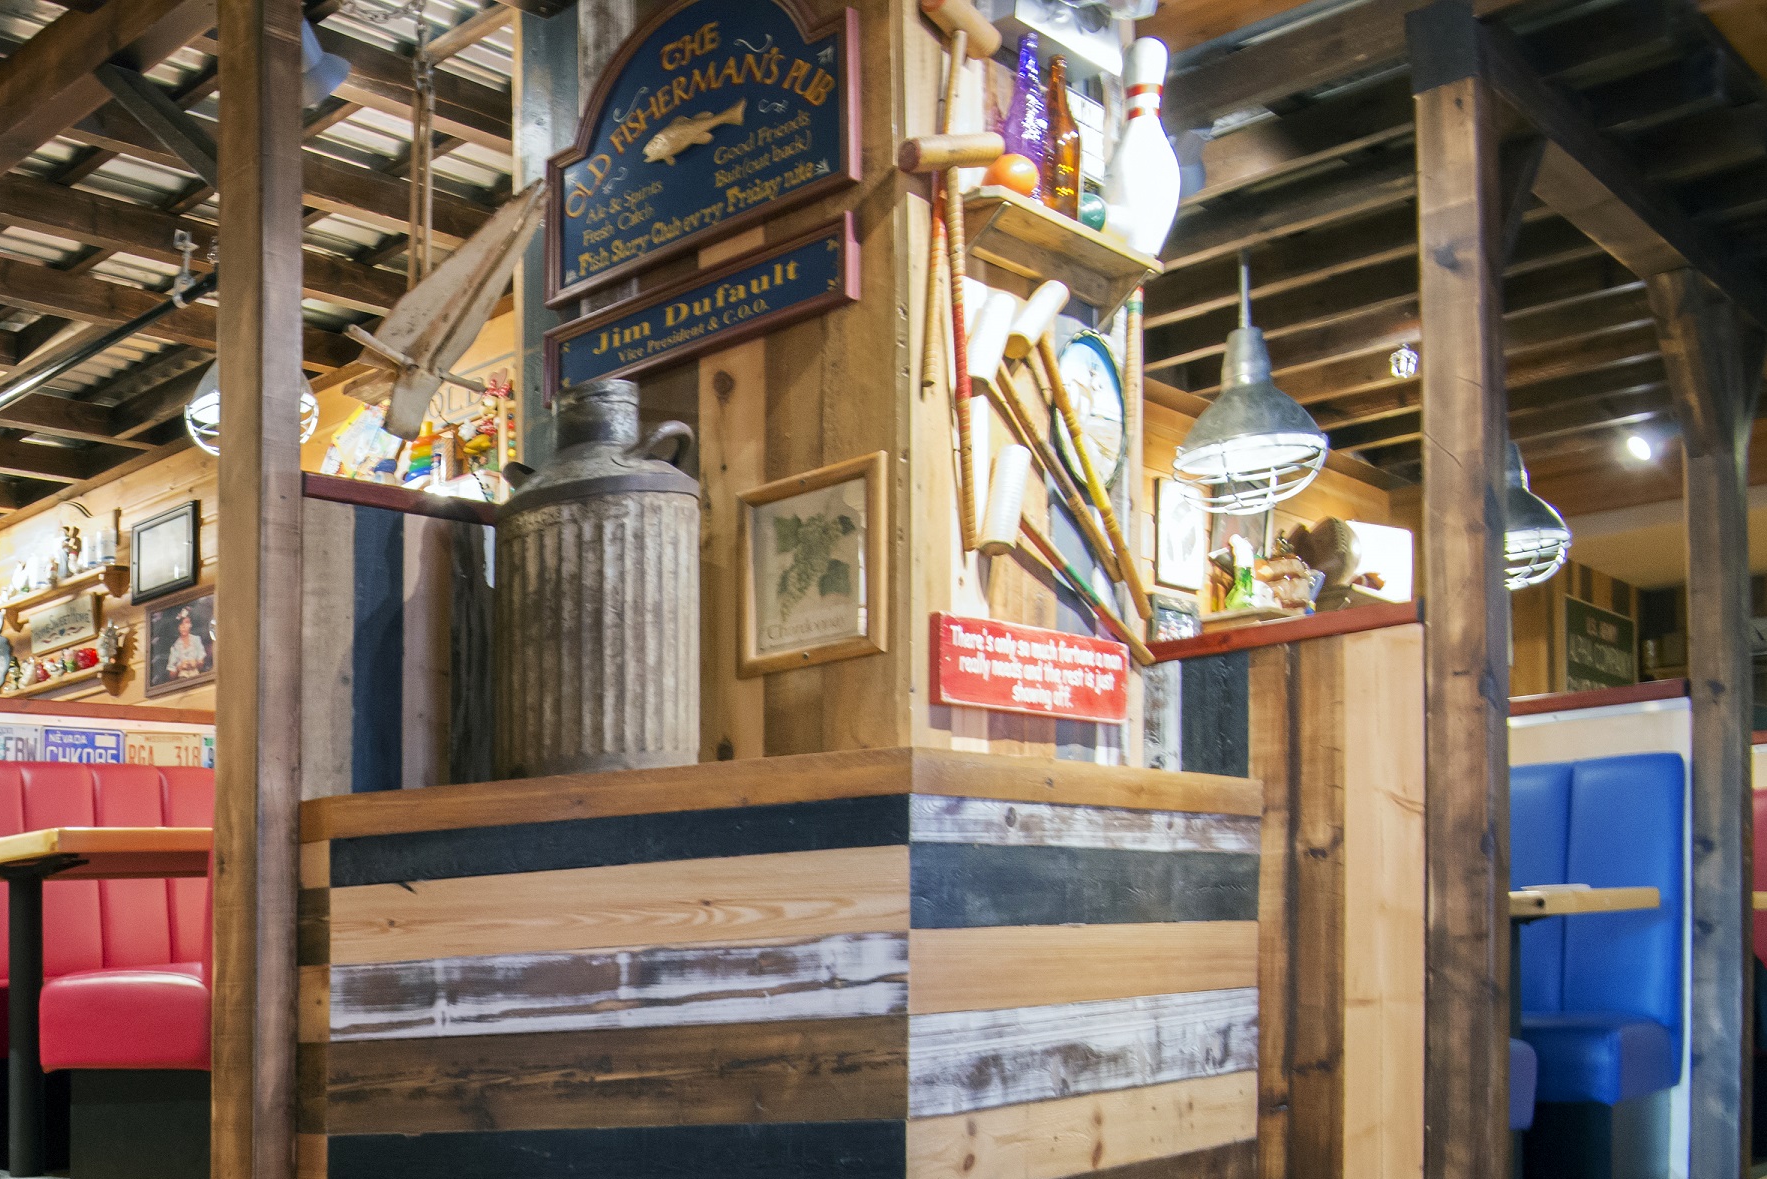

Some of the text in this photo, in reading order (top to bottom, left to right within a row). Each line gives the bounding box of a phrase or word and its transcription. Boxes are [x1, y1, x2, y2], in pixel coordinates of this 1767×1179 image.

[660, 21, 721, 71] THE
[564, 47, 836, 219] OLD FISHERMAN'S PUB
[714, 109, 811, 165] Good Friends
[578, 247, 611, 276] Fish
[726, 175, 782, 212] Friday
[583, 220, 615, 246] Fresh
[592, 260, 800, 355] Jim Dufault
[618, 346, 644, 363] Vice
[646, 322, 705, 353] President
[707, 316, 720, 331] &
[949, 624, 1123, 671] There's only so much fortune a man
[959, 651, 1115, 696] really needs and the rest is just
[1012, 680, 1053, 711] showing
[48, 731, 88, 745] NEVADA
